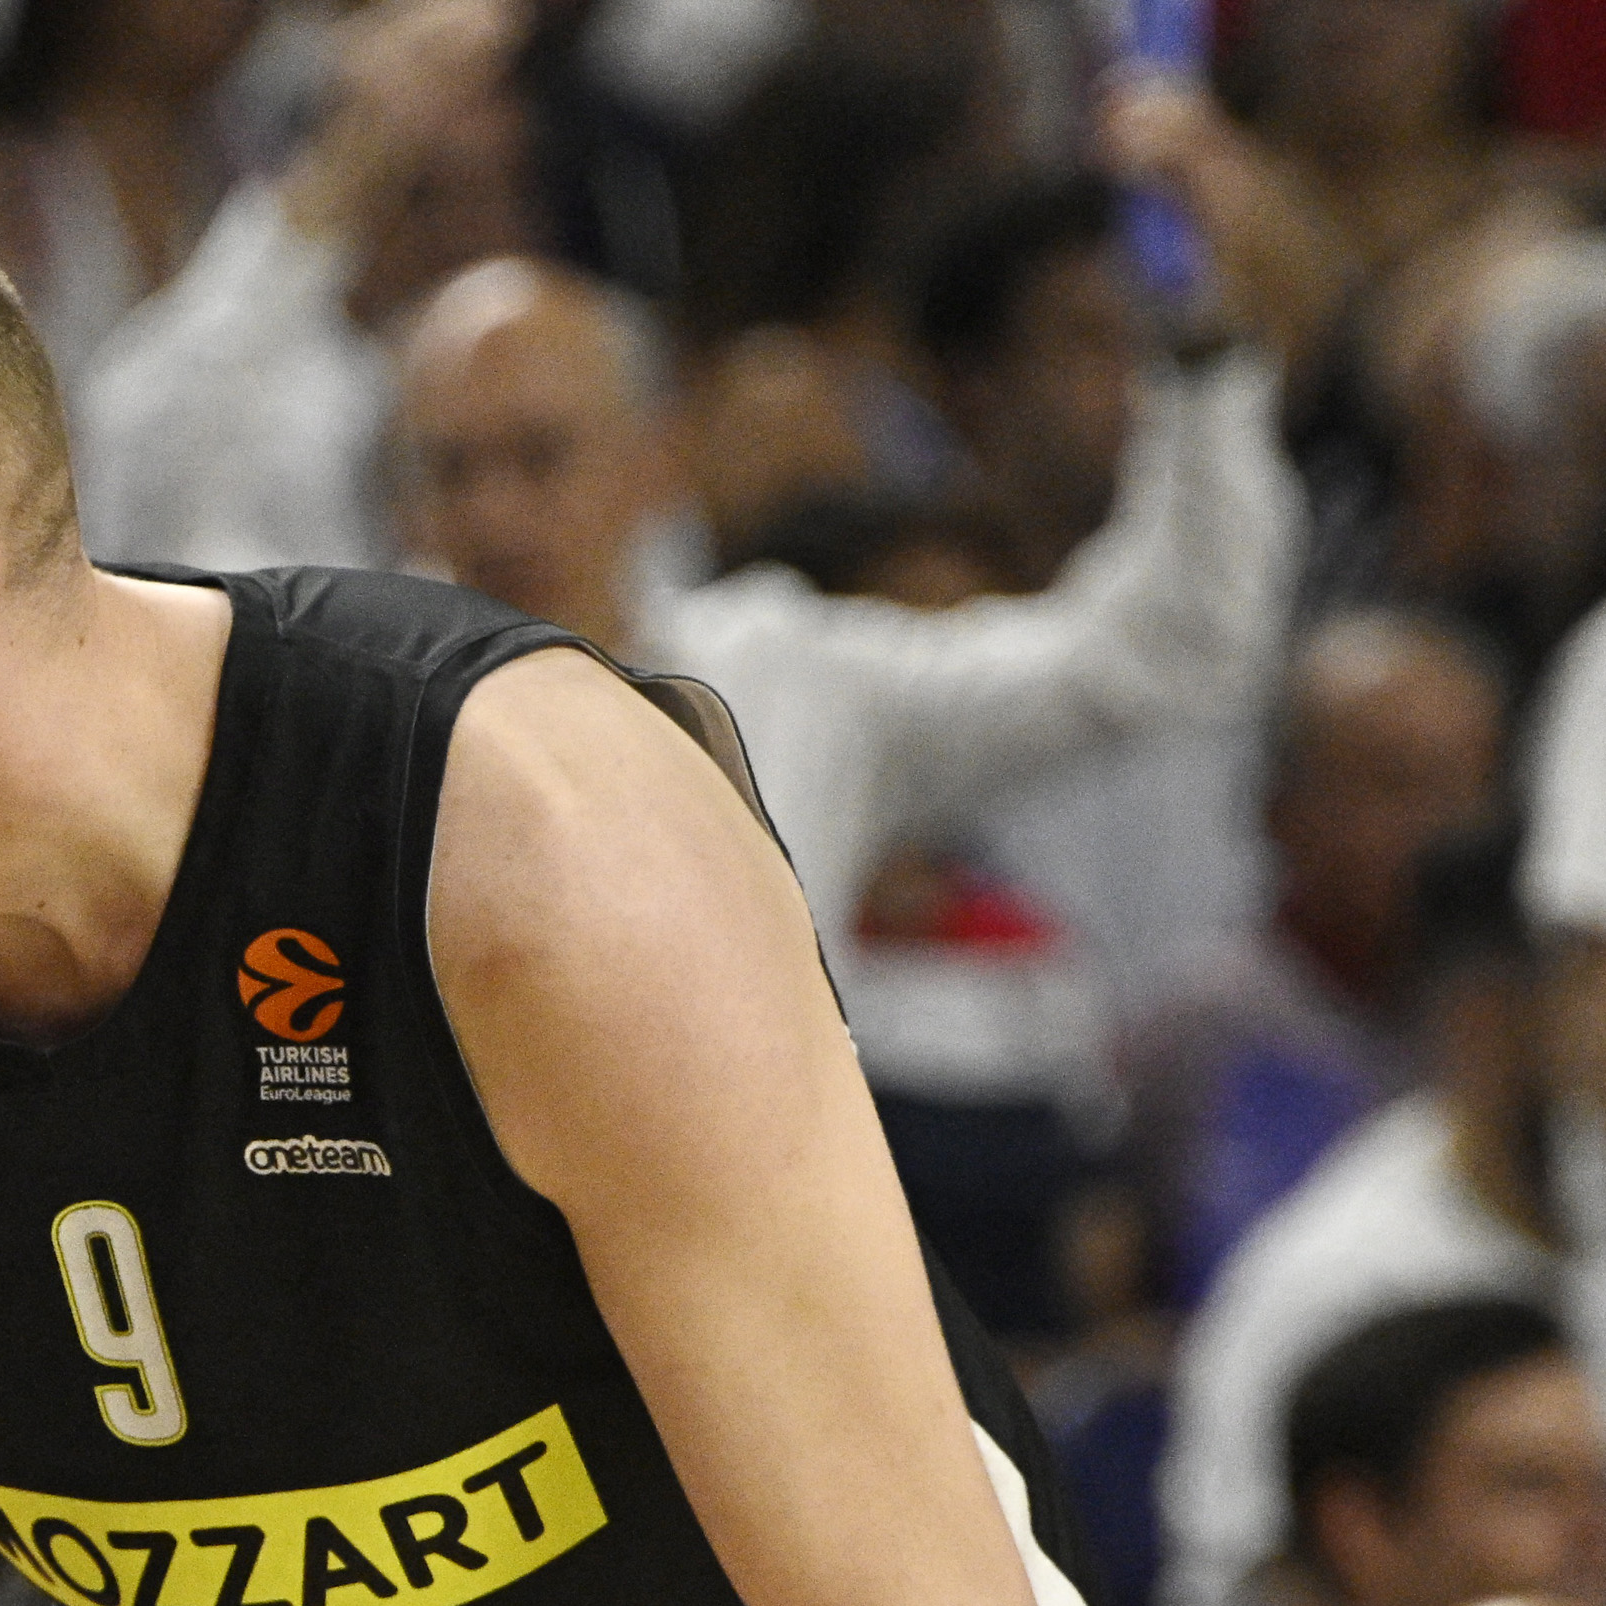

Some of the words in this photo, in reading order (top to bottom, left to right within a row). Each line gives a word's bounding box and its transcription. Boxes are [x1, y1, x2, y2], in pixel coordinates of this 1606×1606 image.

[255, 1046, 348, 1064] TURKISH
[260, 1066, 350, 1083] AIRLINES
[260, 1085, 351, 1104] EuroLeague
[248, 1139, 389, 1174] oneteam
[51, 1200, 187, 1446] 9
